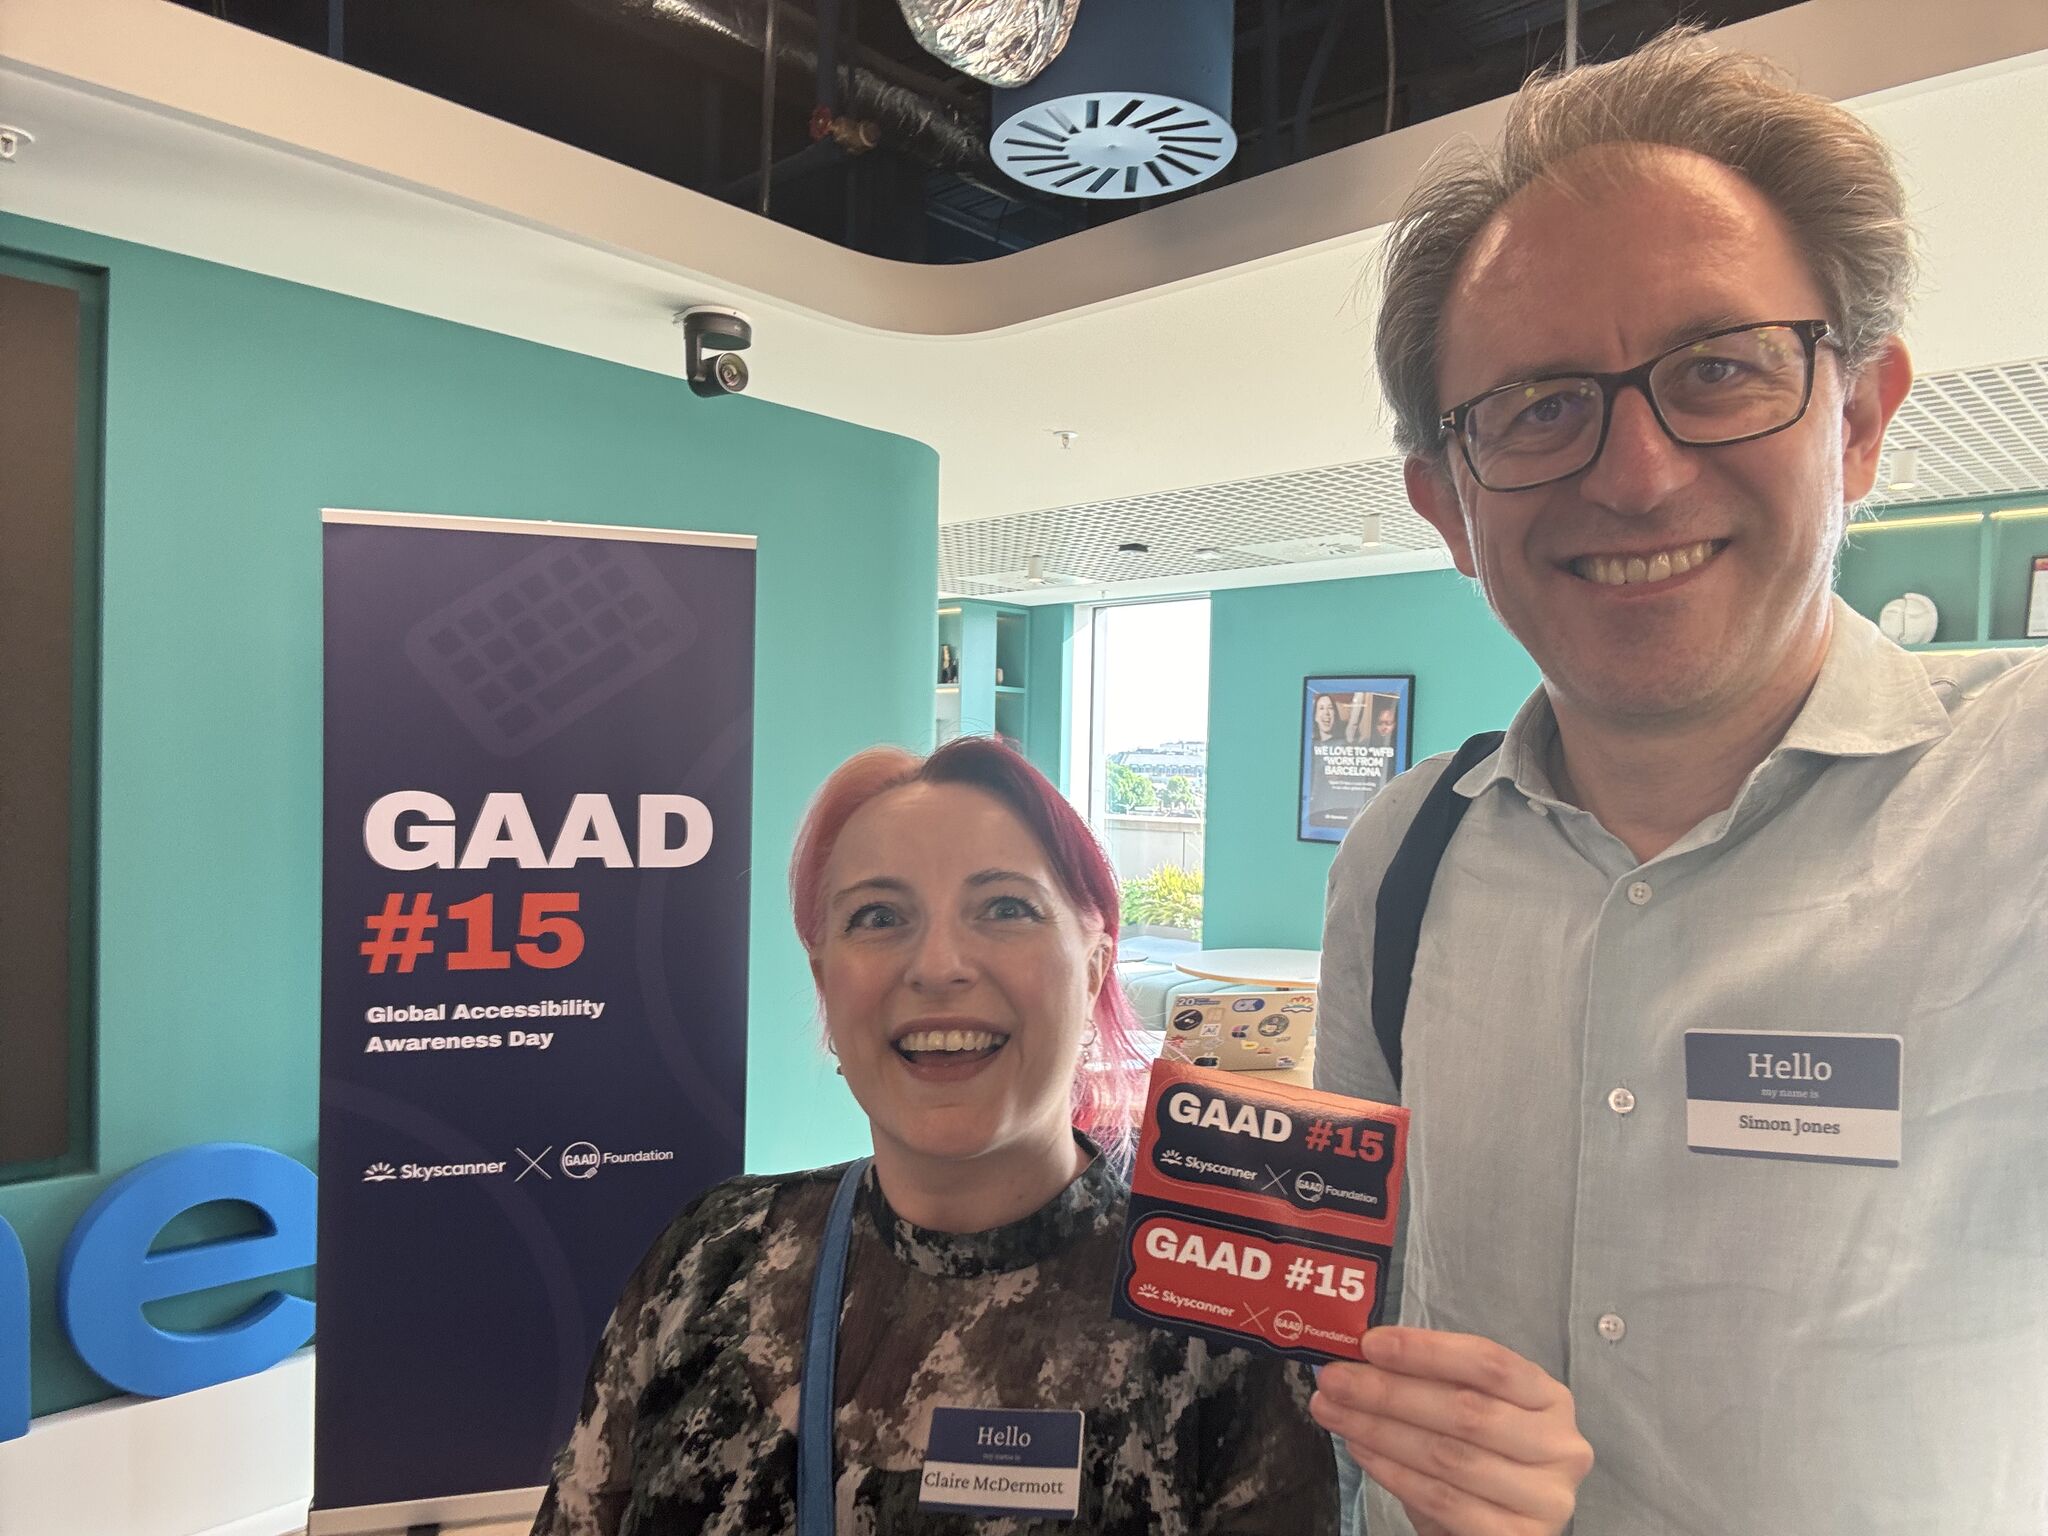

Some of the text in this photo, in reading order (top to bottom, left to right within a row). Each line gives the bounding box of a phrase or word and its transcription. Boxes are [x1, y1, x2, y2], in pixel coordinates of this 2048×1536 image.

[1313, 746, 1329, 756] WE
[1329, 746, 1354, 757] LOVE
[1354, 746, 1368, 757] TO
[1355, 757, 1384, 768] FROM
[1324, 766, 1381, 777] BARCELONA
[363, 790, 714, 871] GAAD
[360, 892, 586, 974] #15
[365, 999, 605, 1024] Global Accessibility
[364, 1030, 554, 1053] Awareness Day
[1747, 1052, 1833, 1081] Hello
[1761, 1089, 1819, 1099] my name is
[1168, 1091, 1384, 1163] GAAD #15
[1739, 1115, 1841, 1136] Simon Jones
[399, 1160, 507, 1183] Skyscanner
[564, 1153, 598, 1167] GAAD
[603, 1149, 674, 1165] Foundation
[1184, 1155, 1258, 1182] Skyscanner
[1298, 1179, 1322, 1193] GAAD
[1325, 1185, 1378, 1205] Foundation
[1145, 1227, 1365, 1302] GAAD #15
[1161, 1289, 1235, 1318] Skyscanner
[1303, 1324, 1359, 1346] Foundation
[977, 1425, 1032, 1448] Hello
[924, 1471, 1065, 1494] Claire McDermott
